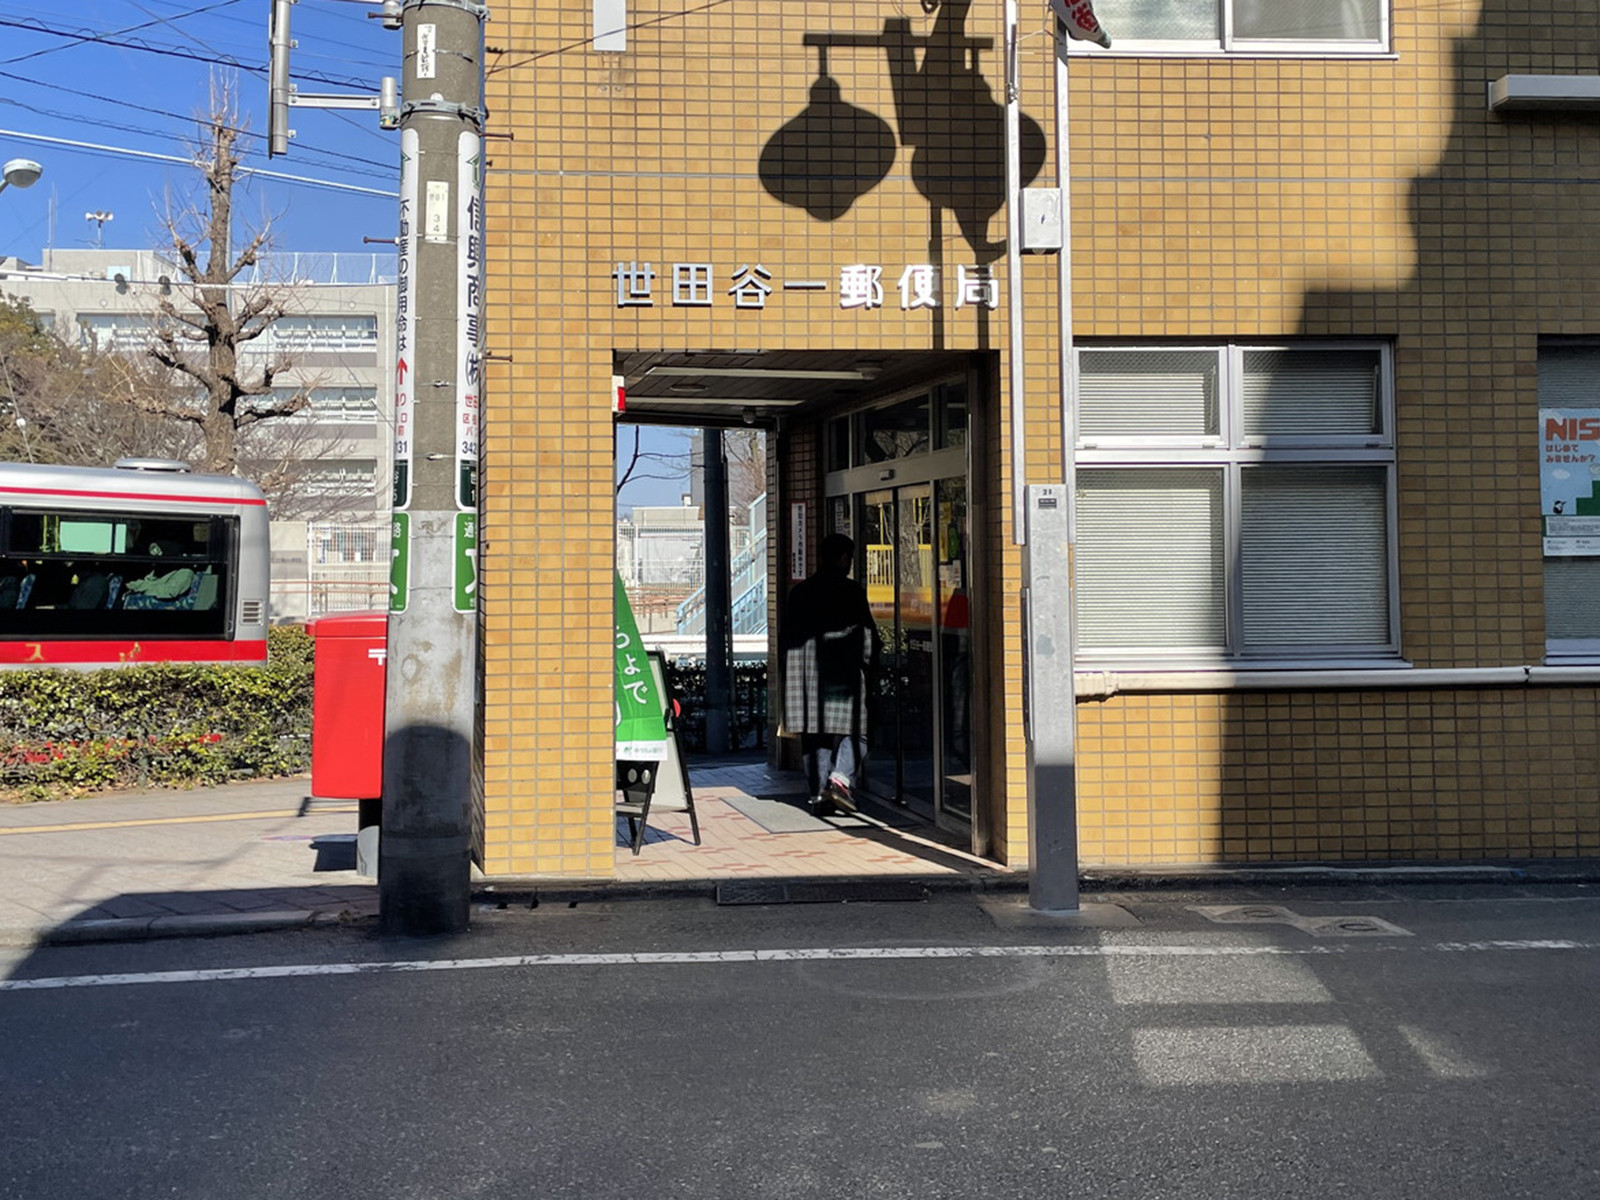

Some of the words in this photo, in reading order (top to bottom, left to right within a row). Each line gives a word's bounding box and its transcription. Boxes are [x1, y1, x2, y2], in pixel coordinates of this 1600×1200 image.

[612, 261, 999, 310] 世田谷一郵便局
[1545, 444, 1579, 452] はじめて
